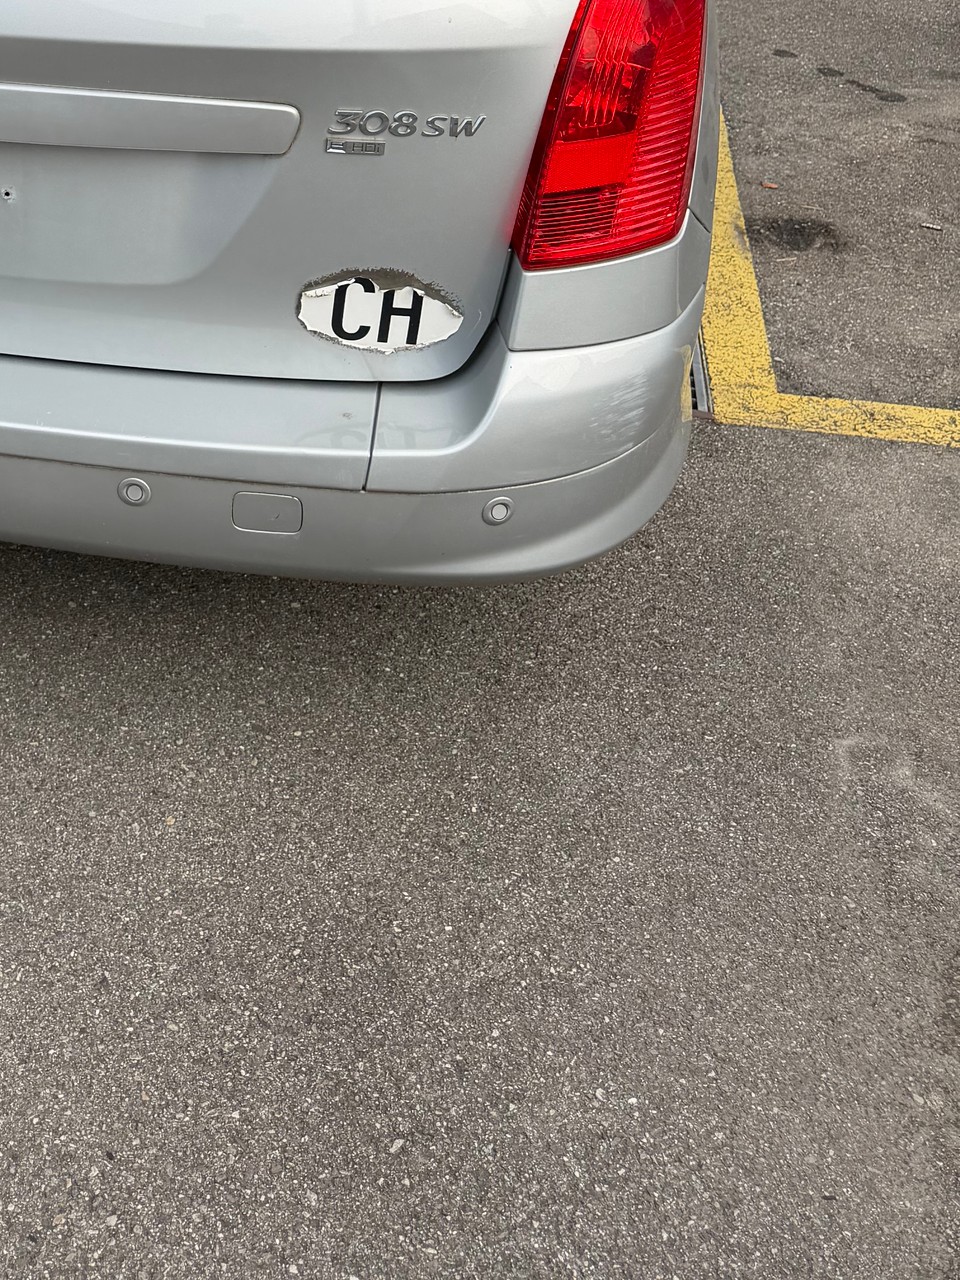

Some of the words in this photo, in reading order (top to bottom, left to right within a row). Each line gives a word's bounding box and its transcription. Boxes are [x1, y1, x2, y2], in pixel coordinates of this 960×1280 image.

[327, 108, 418, 136] 308
[421, 113, 487, 137] SW
[331, 277, 423, 345] CH
